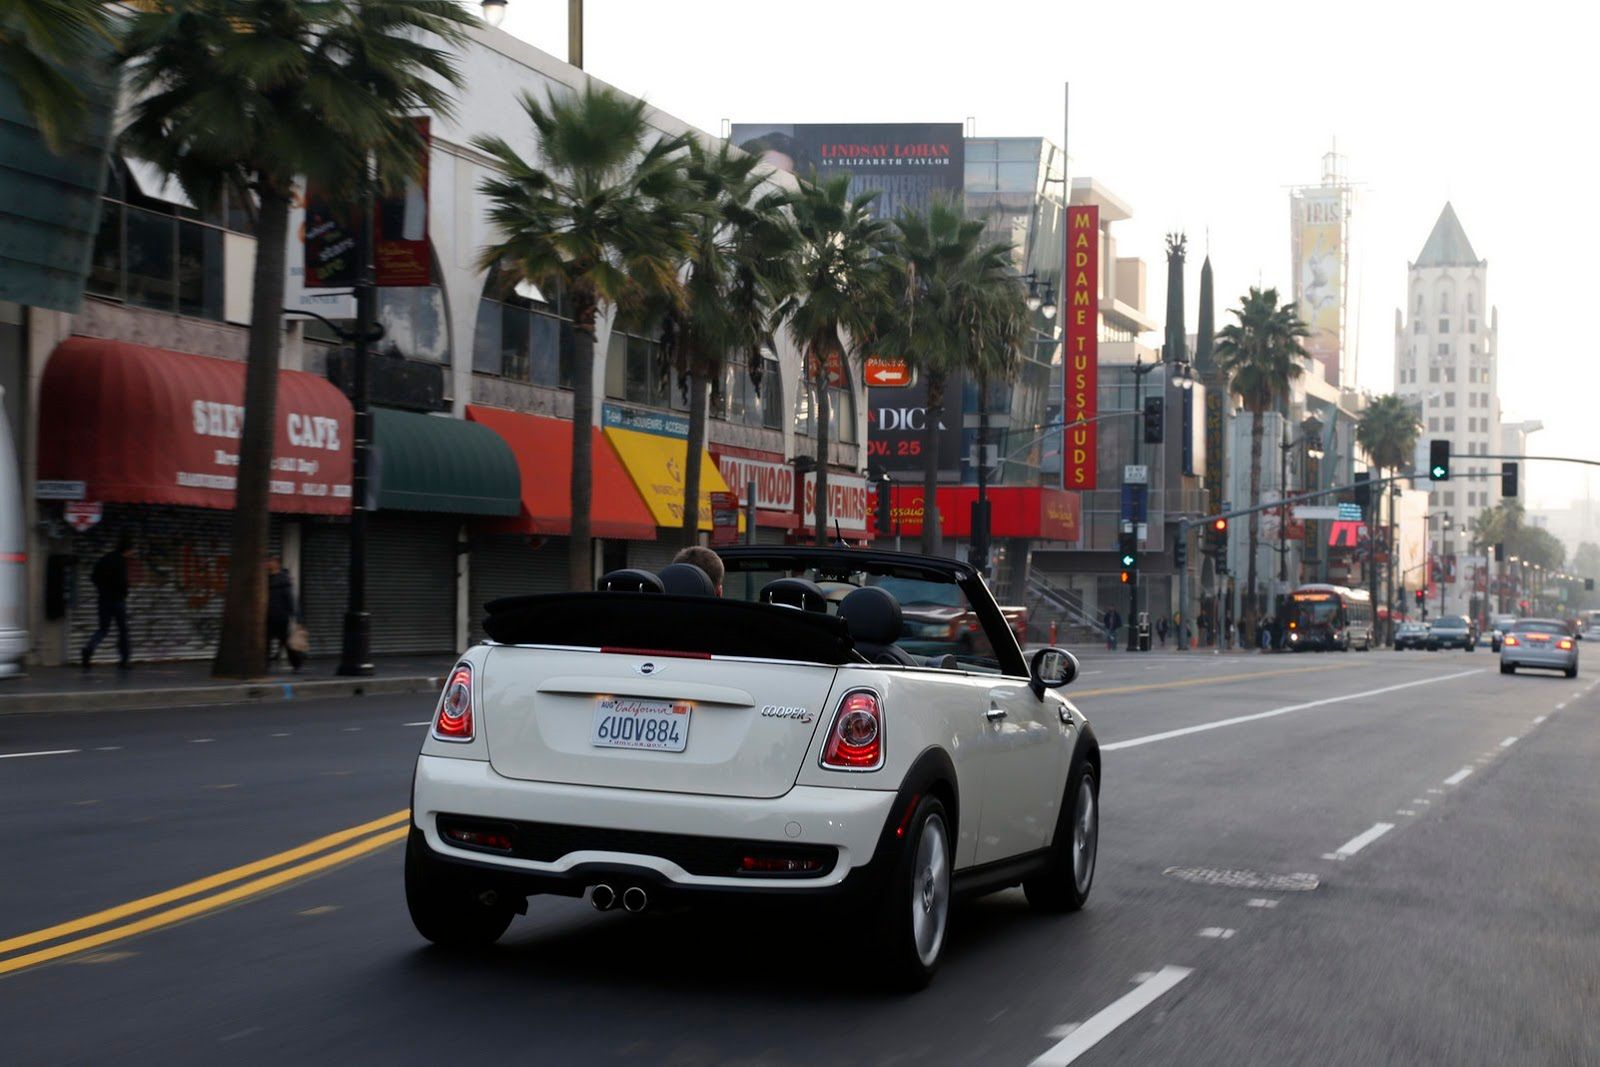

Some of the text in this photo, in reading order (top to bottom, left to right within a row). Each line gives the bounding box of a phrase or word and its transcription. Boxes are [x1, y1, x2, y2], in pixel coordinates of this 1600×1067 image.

[821, 144, 949, 157] LINDSAY LOHAN
[839, 158, 902, 166] ELIZABETH
[1073, 213, 1090, 483] MADAME TUSSAUDS
[192, 400, 341, 450] SHE CAFE
[898, 441, 921, 455] 25
[805, 480, 865, 520] SOVENIRS
[615, 700, 673, 717] California
[761, 704, 806, 720] COOPER
